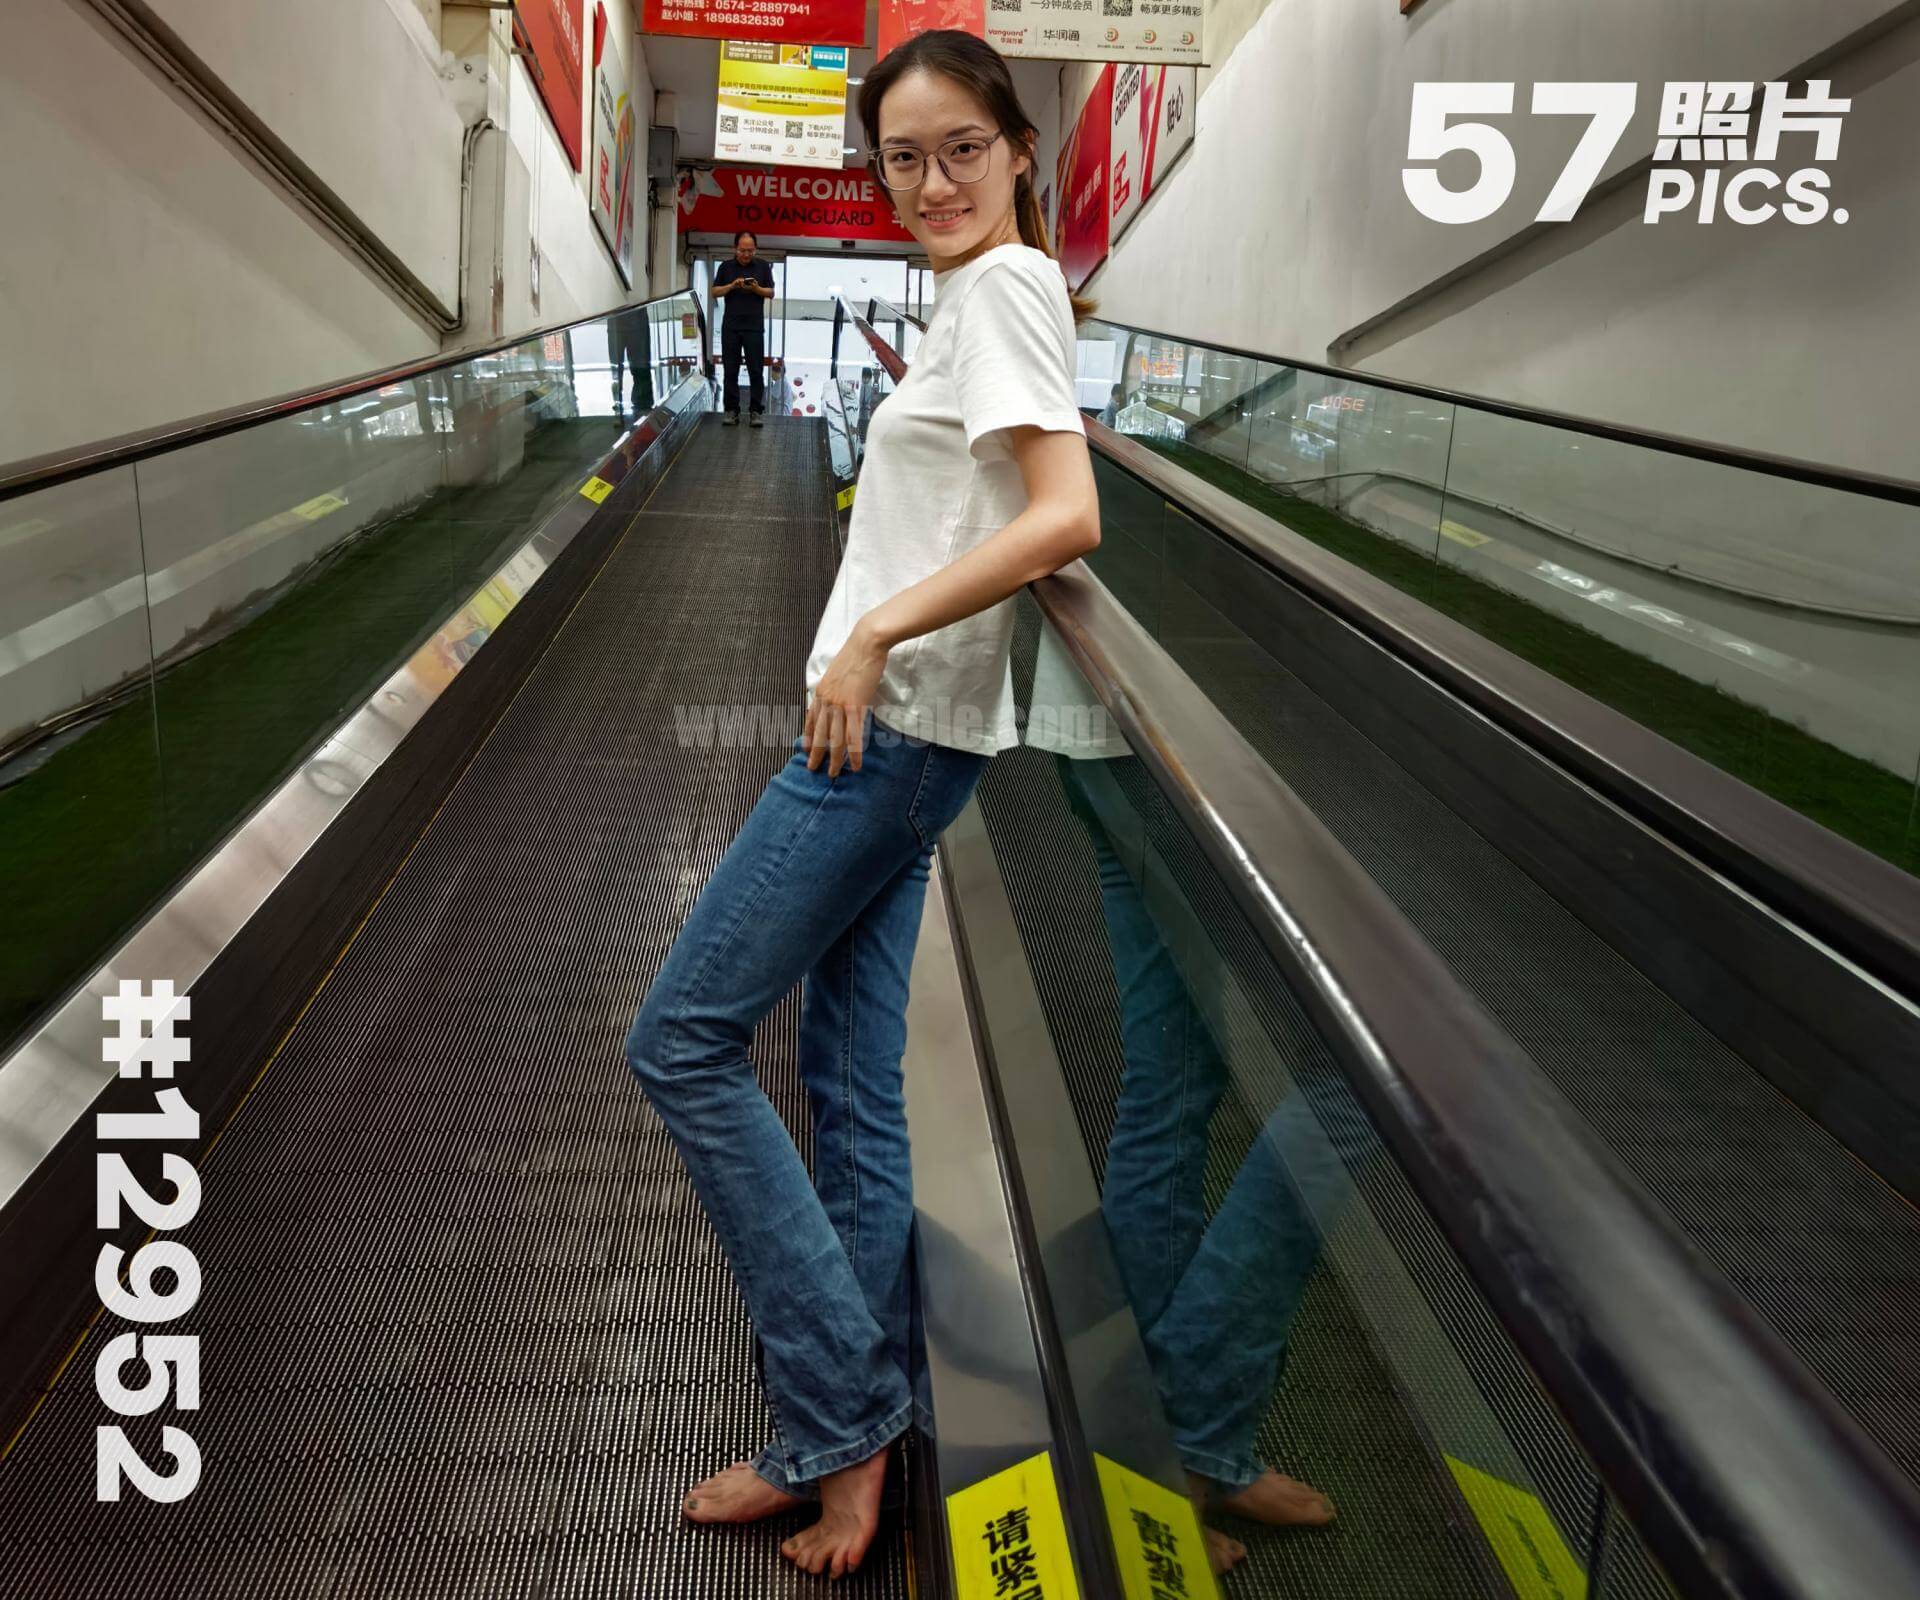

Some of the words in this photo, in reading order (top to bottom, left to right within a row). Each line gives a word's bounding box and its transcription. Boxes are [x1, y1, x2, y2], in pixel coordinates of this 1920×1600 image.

[715, 0, 811, 15] 0574-28897941
[704, 13, 785, 27] 18968326330
[736, 174, 875, 202] WELCOME
[736, 205, 762, 222] TO
[767, 207, 874, 226] VANGUARD
